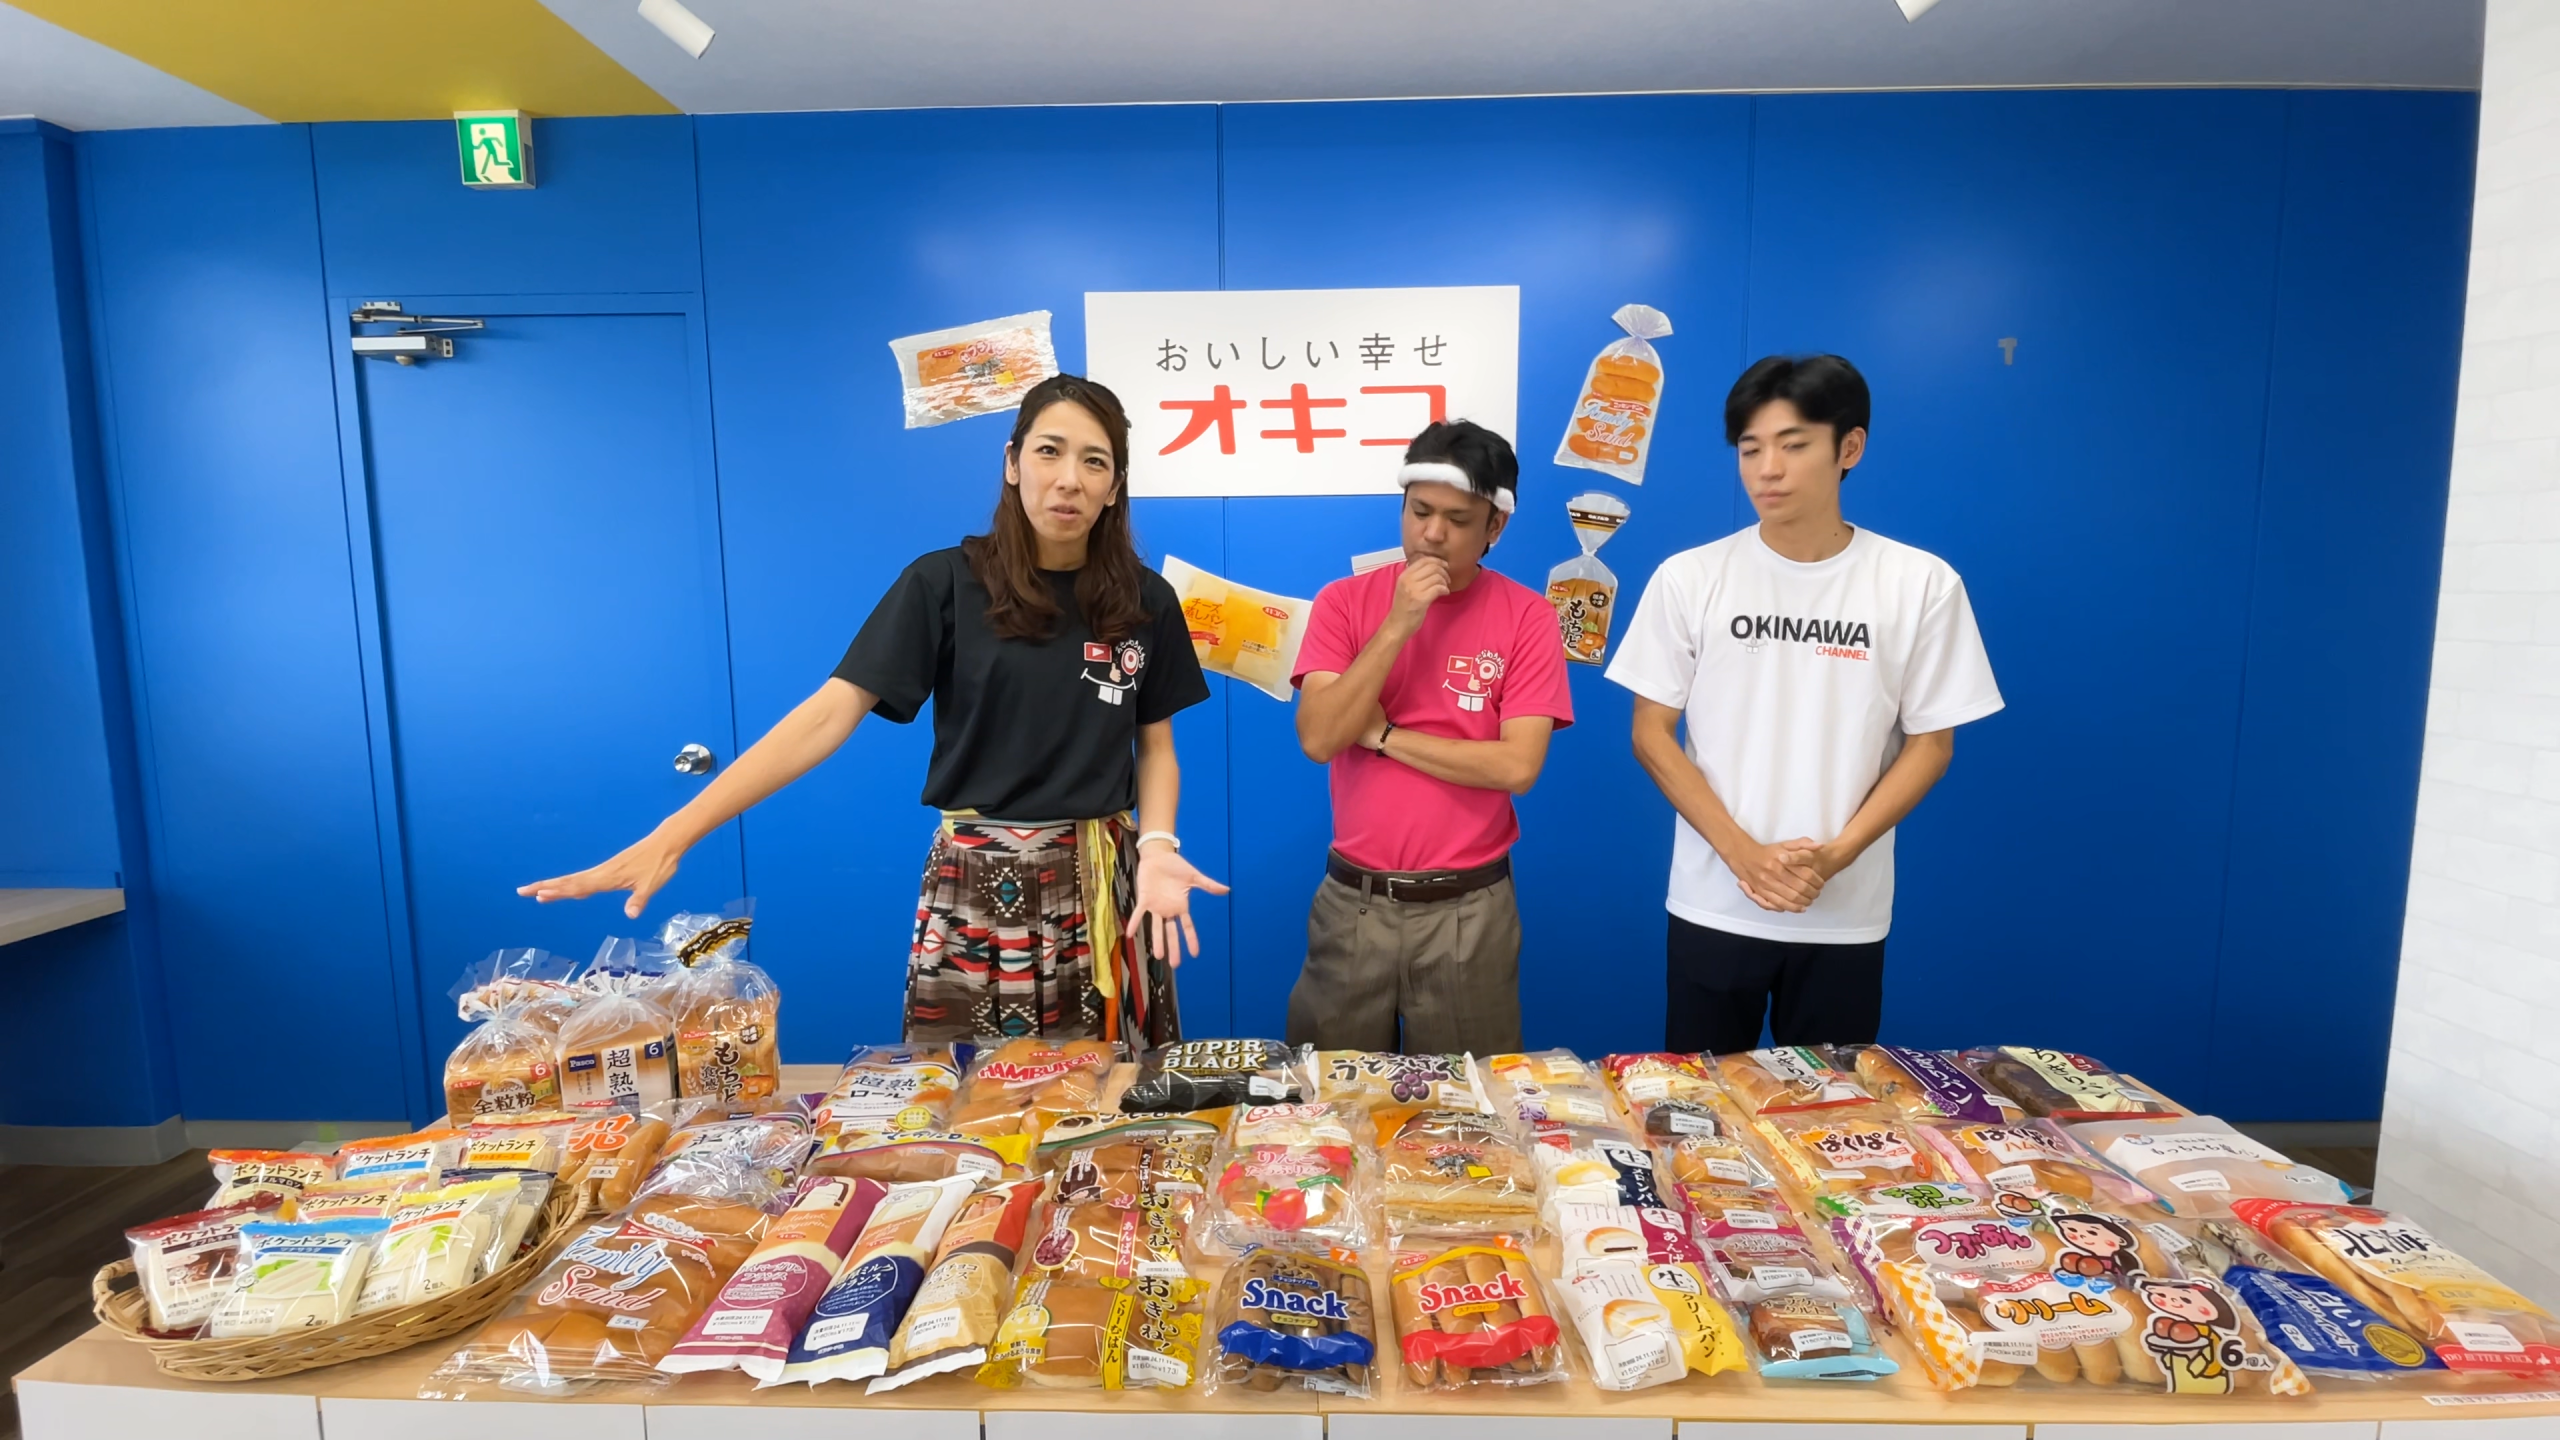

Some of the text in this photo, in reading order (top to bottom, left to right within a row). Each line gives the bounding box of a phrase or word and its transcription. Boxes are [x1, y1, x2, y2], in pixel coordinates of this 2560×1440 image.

[1156, 333, 1447, 372] おいしい幸せ
[1158, 383, 1447, 456] オキコ
[1577, 399, 1635, 431] Family
[1586, 422, 1635, 447] Sand
[1192, 598, 1222, 613] チーズ
[1568, 600, 1586, 649] もちっと
[1731, 615, 1871, 648] OKINAWA
[1815, 646, 1869, 661] CHANNEL
[649, 1043, 660, 1055] 6
[1166, 1039, 1263, 1058] SUPER
[534, 1063, 547, 1076] 6
[569, 1059, 595, 1068] Pasco
[607, 1049, 634, 1095] 超熟
[714, 1042, 743, 1102] もちっと
[979, 1052, 1102, 1080] HAMBURGER
[1163, 1053, 1267, 1070] BLACK
[702, 1066, 718, 1091] 食感
[850, 1075, 917, 1091] 超熟
[474, 1091, 536, 1115] 全粒粉
[850, 1090, 905, 1098] ロール
[1814, 1132, 1902, 1152] ぱくぱく
[1257, 1151, 1315, 1164] りんご
[1832, 1147, 1909, 1162] ウィンナーマヨ
[234, 1163, 324, 1184] ポケットランチ
[250, 1176, 302, 1188] ダブルマロン
[303, 1194, 388, 1211] ポケットランチ
[1118, 1221, 1135, 1266] あんぱん
[1919, 1223, 2032, 1259] つぶあん
[564, 1226, 672, 1289] Family
[538, 1264, 667, 1310] Sand
[836, 1273, 881, 1293] フランス
[1658, 1270, 1684, 1287] 生
[1241, 1278, 1350, 1319] Snack
[1418, 1272, 1528, 1312] Snack
[1137, 1275, 1179, 1352] おっきいね!
[1275, 1316, 1313, 1324] チョコチップ
[1457, 1303, 1497, 1313] スナックパン
[1995, 1292, 2113, 1325] クリーム
[2301, 1290, 2362, 1328] 白い
[1106, 1299, 1126, 1364] くりーむぱん
[1682, 1294, 1715, 1359] クリームパン
[2464, 1353, 2502, 1363] BUTTER
